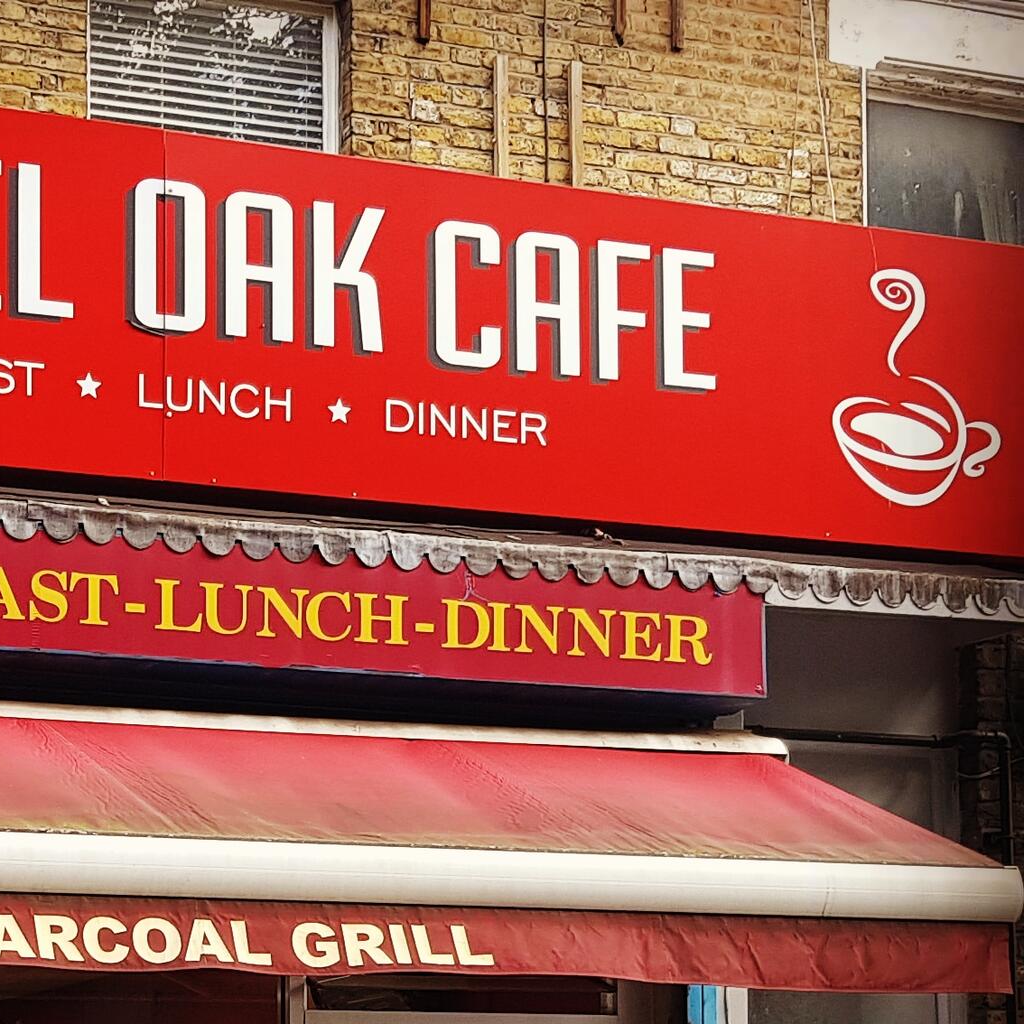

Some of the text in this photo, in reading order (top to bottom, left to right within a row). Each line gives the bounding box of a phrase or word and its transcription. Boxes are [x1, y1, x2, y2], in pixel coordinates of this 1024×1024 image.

[131, 178, 386, 353] OAK
[431, 220, 716, 391] CAFE
[138, 373, 292, 421] LUNCH
[385, 398, 548, 447] DINNER
[291, 922, 496, 968] GRILL
